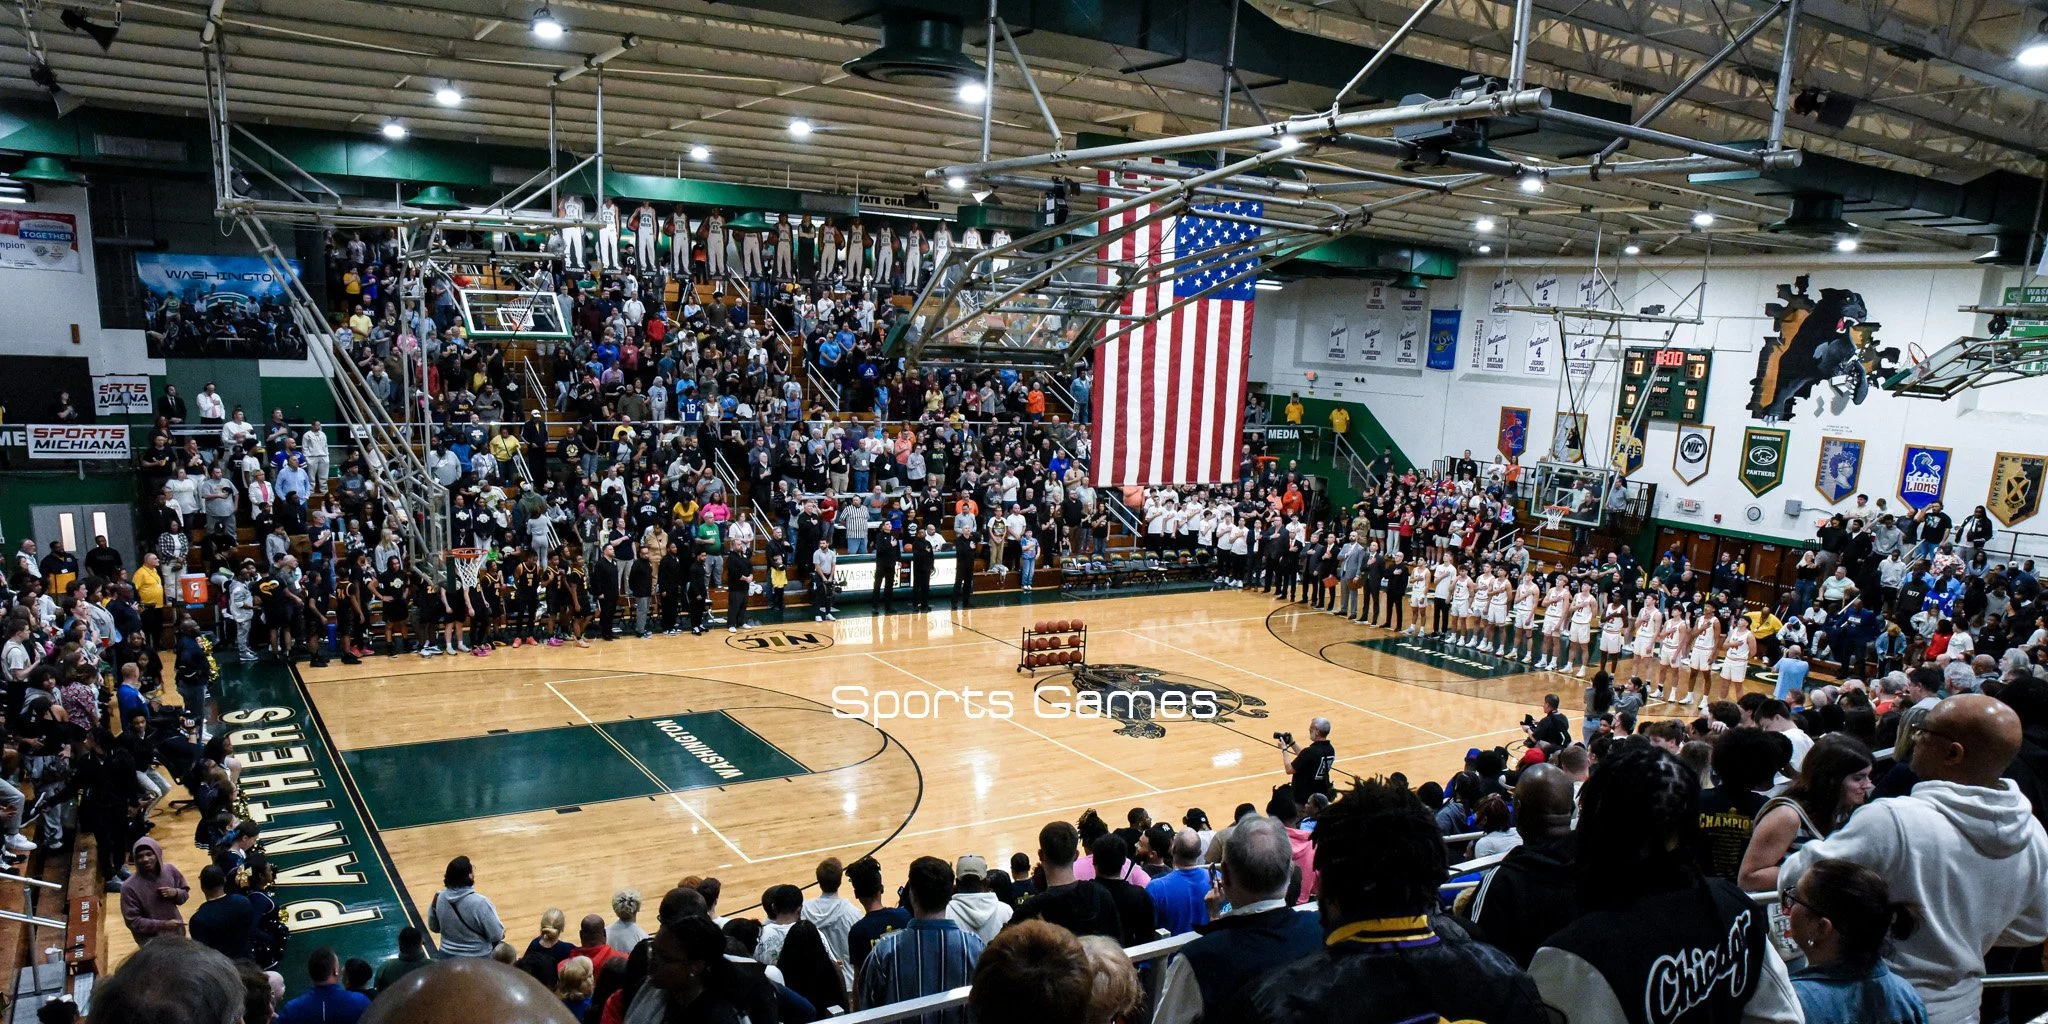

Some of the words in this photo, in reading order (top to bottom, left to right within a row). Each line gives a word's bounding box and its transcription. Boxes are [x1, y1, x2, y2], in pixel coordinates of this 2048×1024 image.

[23, 231, 71, 240] TOGETHER
[1542, 289, 1549, 300] 2
[1370, 338, 1375, 348] 2
[1404, 339, 1412, 350] 15
[1487, 334, 1507, 346] Indiana
[1529, 336, 1549, 348] Indiana
[1573, 338, 1595, 351] Indiana
[1535, 346, 1541, 358] 4
[1580, 348, 1586, 359] 4
[1633, 360, 1643, 375] 0
[1694, 363, 1705, 379] 0
[686, 403, 696, 414] 18
[1687, 398, 1696, 410] 0
[33, 428, 125, 439] SPORTS
[1268, 429, 1300, 439] MEDIA
[1751, 434, 1781, 442] WASHINGTON
[34, 440, 127, 449] MICHIANA
[1619, 444, 1642, 455] RHS
[1684, 441, 1702, 454] NIC
[1819, 447, 1829, 486] KNIGHTS
[1746, 469, 1776, 478] PANTHERS
[1905, 481, 1938, 495] LIONS
[1990, 463, 2006, 507] KINGSMEN
[190, 583, 199, 591] G
[737, 633, 820, 650] NIC
[1396, 642, 1495, 670] PANTHERS
[652, 719, 745, 779] WASHINGTON
[217, 706, 383, 932] PANTHERS
[1699, 812, 1753, 830] CHAMPIO
